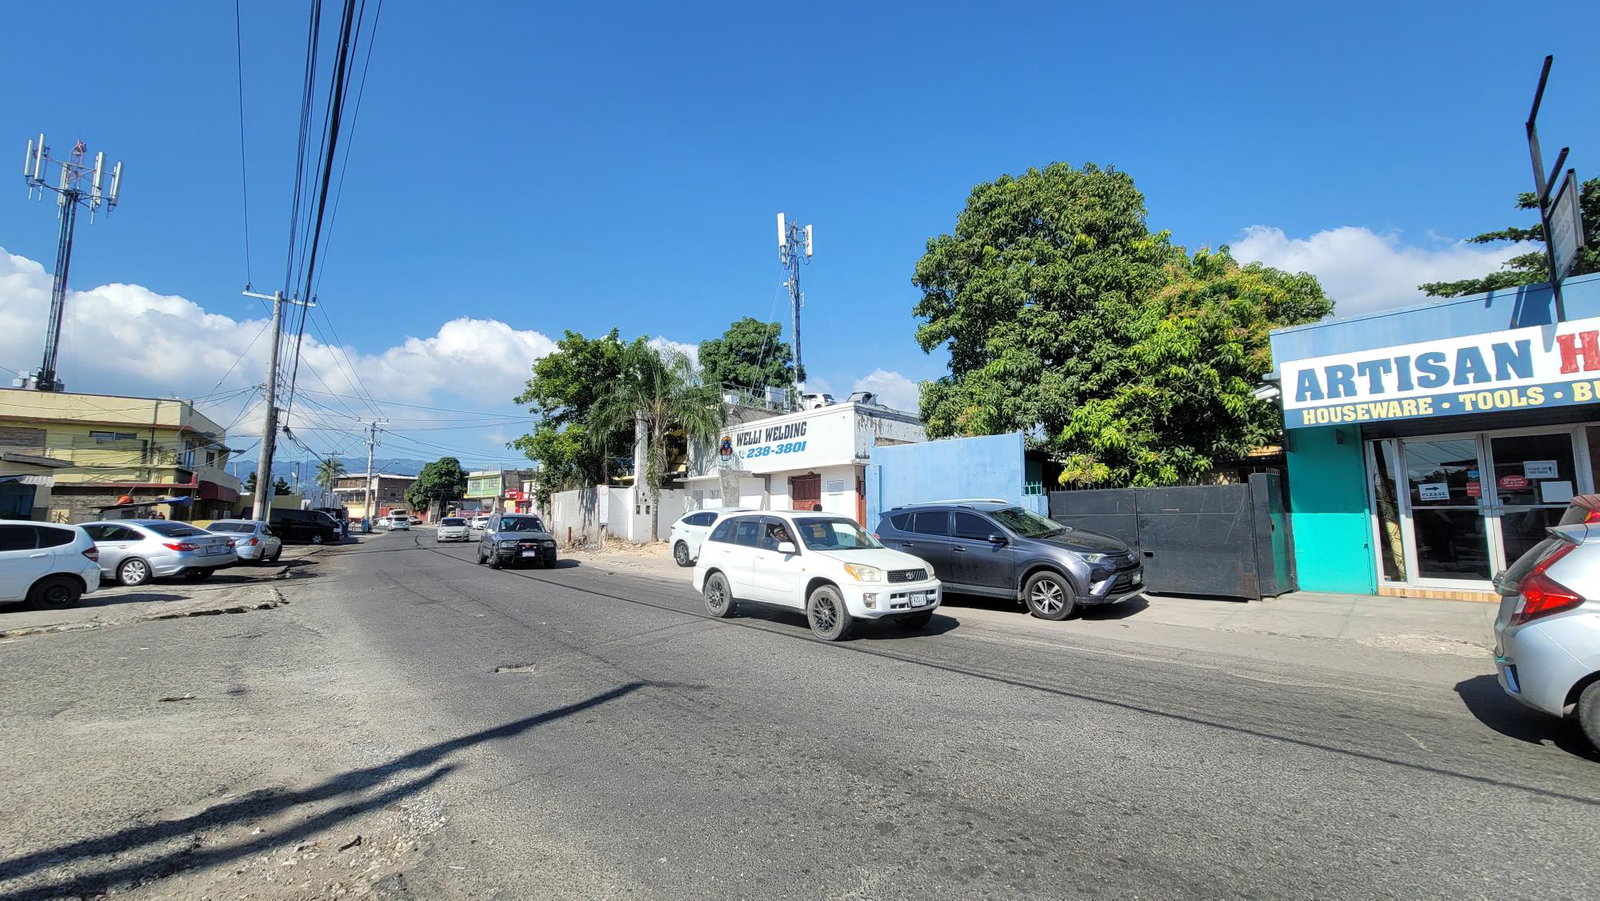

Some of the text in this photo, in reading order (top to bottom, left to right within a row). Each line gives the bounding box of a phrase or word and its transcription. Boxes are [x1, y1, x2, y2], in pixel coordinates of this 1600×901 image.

[1295, 339, 1534, 402] ARTISAN
[1302, 397, 1434, 425] HOUSEWARE
[1458, 386, 1545, 411] TOOLS
[736, 421, 807, 447] WELLI WELDING
[746, 441, 807, 458] 238-3801
